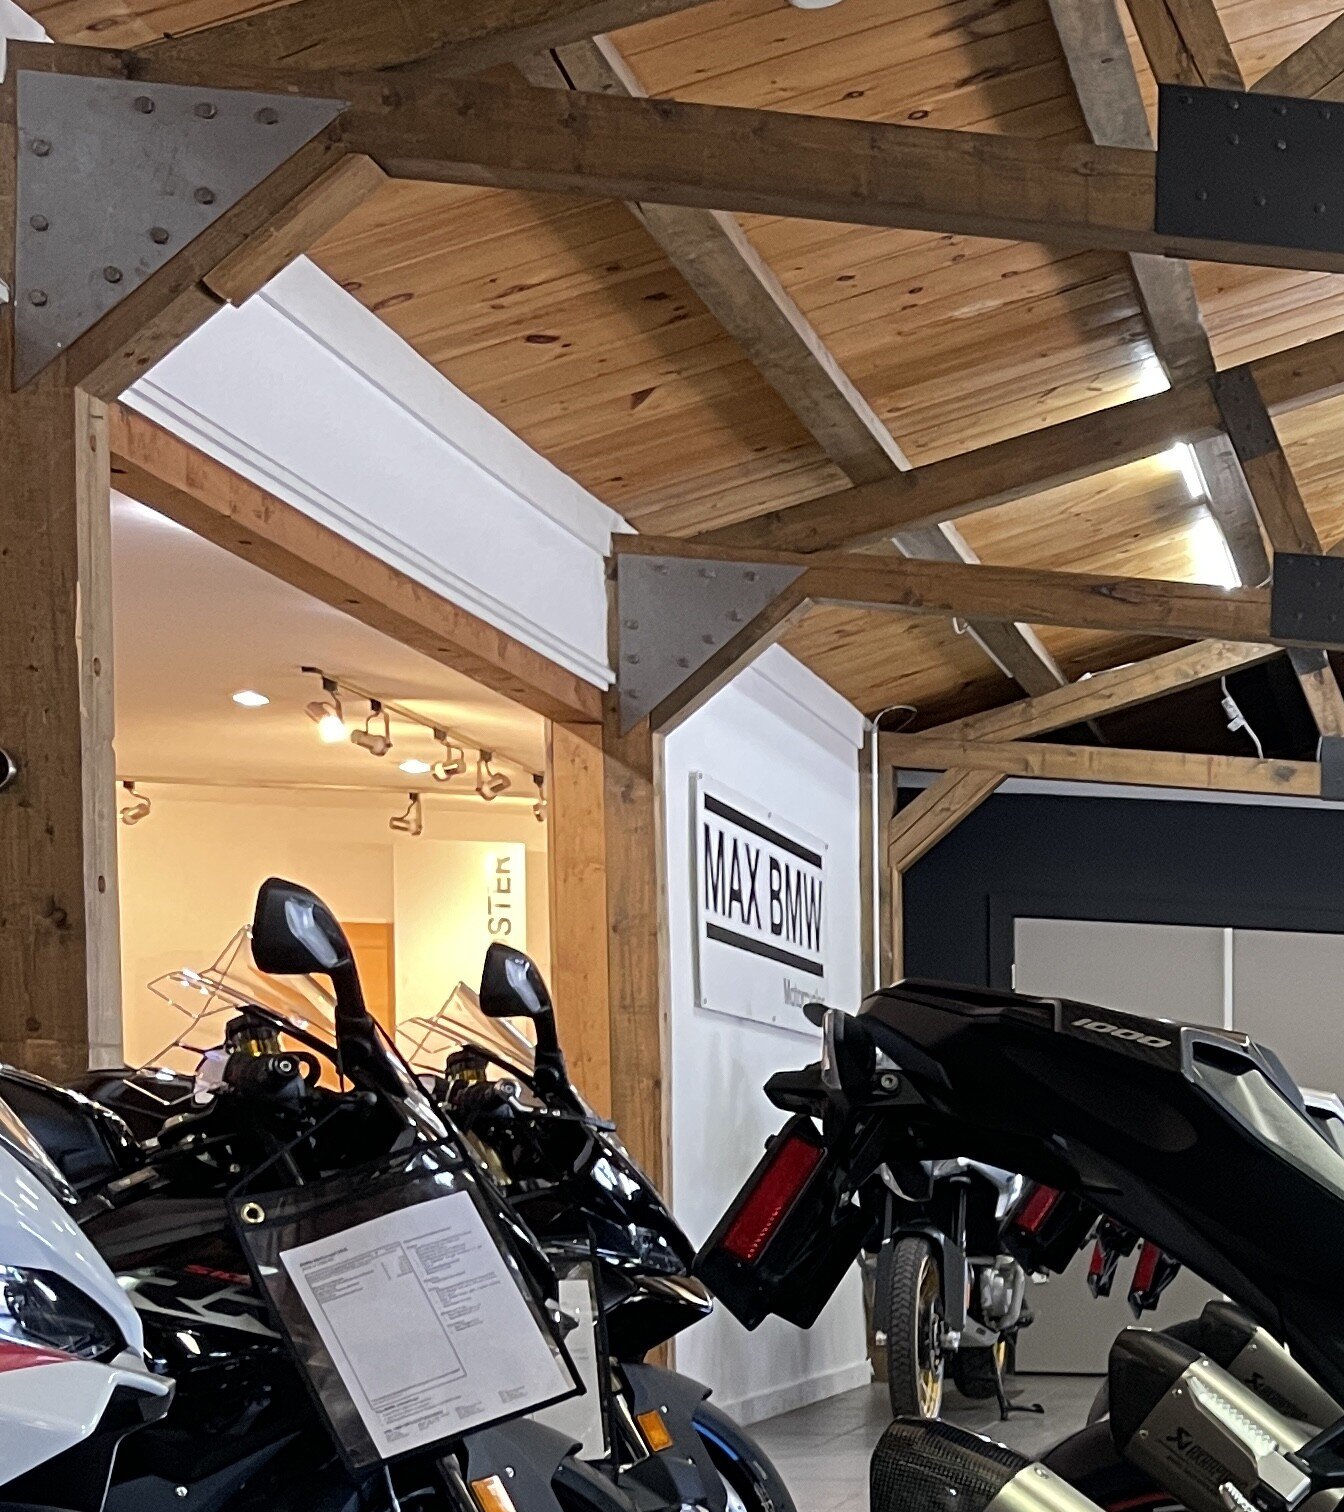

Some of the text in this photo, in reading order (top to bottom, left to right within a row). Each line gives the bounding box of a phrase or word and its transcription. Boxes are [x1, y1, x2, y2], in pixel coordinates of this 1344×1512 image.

[487, 856, 512, 941] STER
[704, 822, 823, 952] MAX BMW
[1071, 1018, 1172, 1048] 1000
